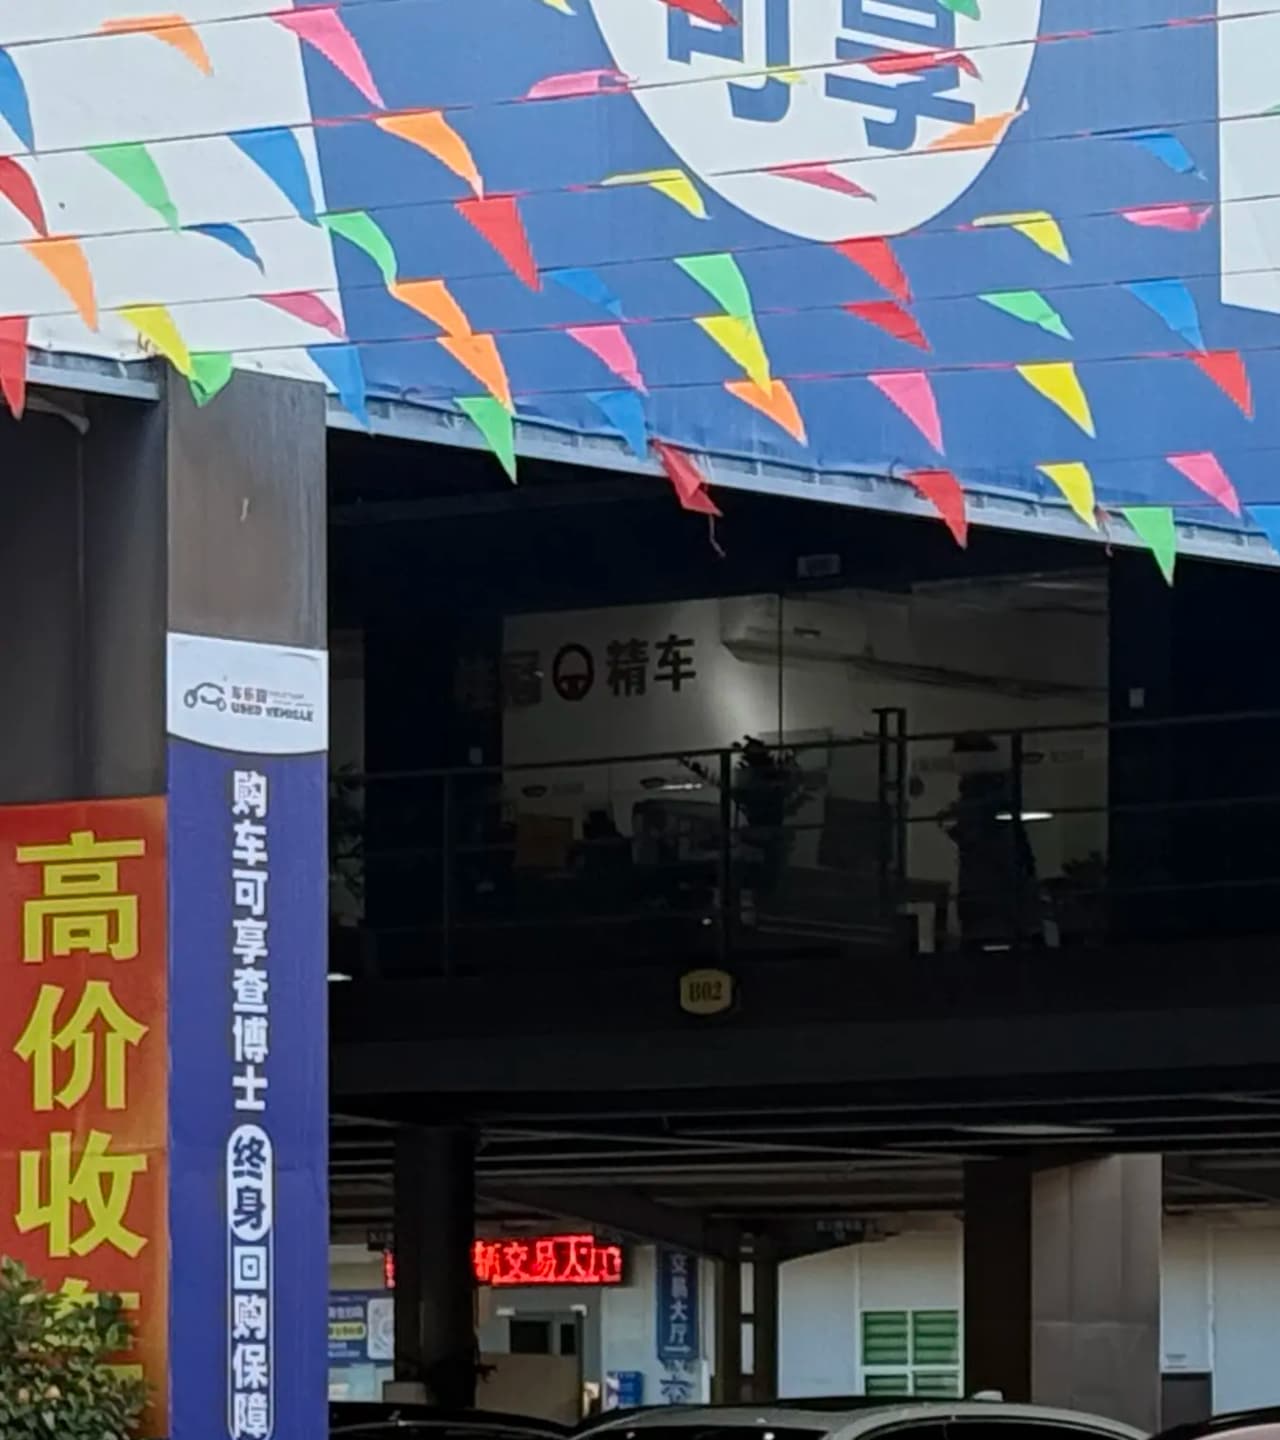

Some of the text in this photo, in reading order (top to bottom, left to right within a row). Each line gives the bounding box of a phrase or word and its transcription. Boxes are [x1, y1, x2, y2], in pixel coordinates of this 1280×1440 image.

[606, 633, 697, 698] 精车
[232, 770, 270, 1440] 购车可享查博士 终身回购保障
